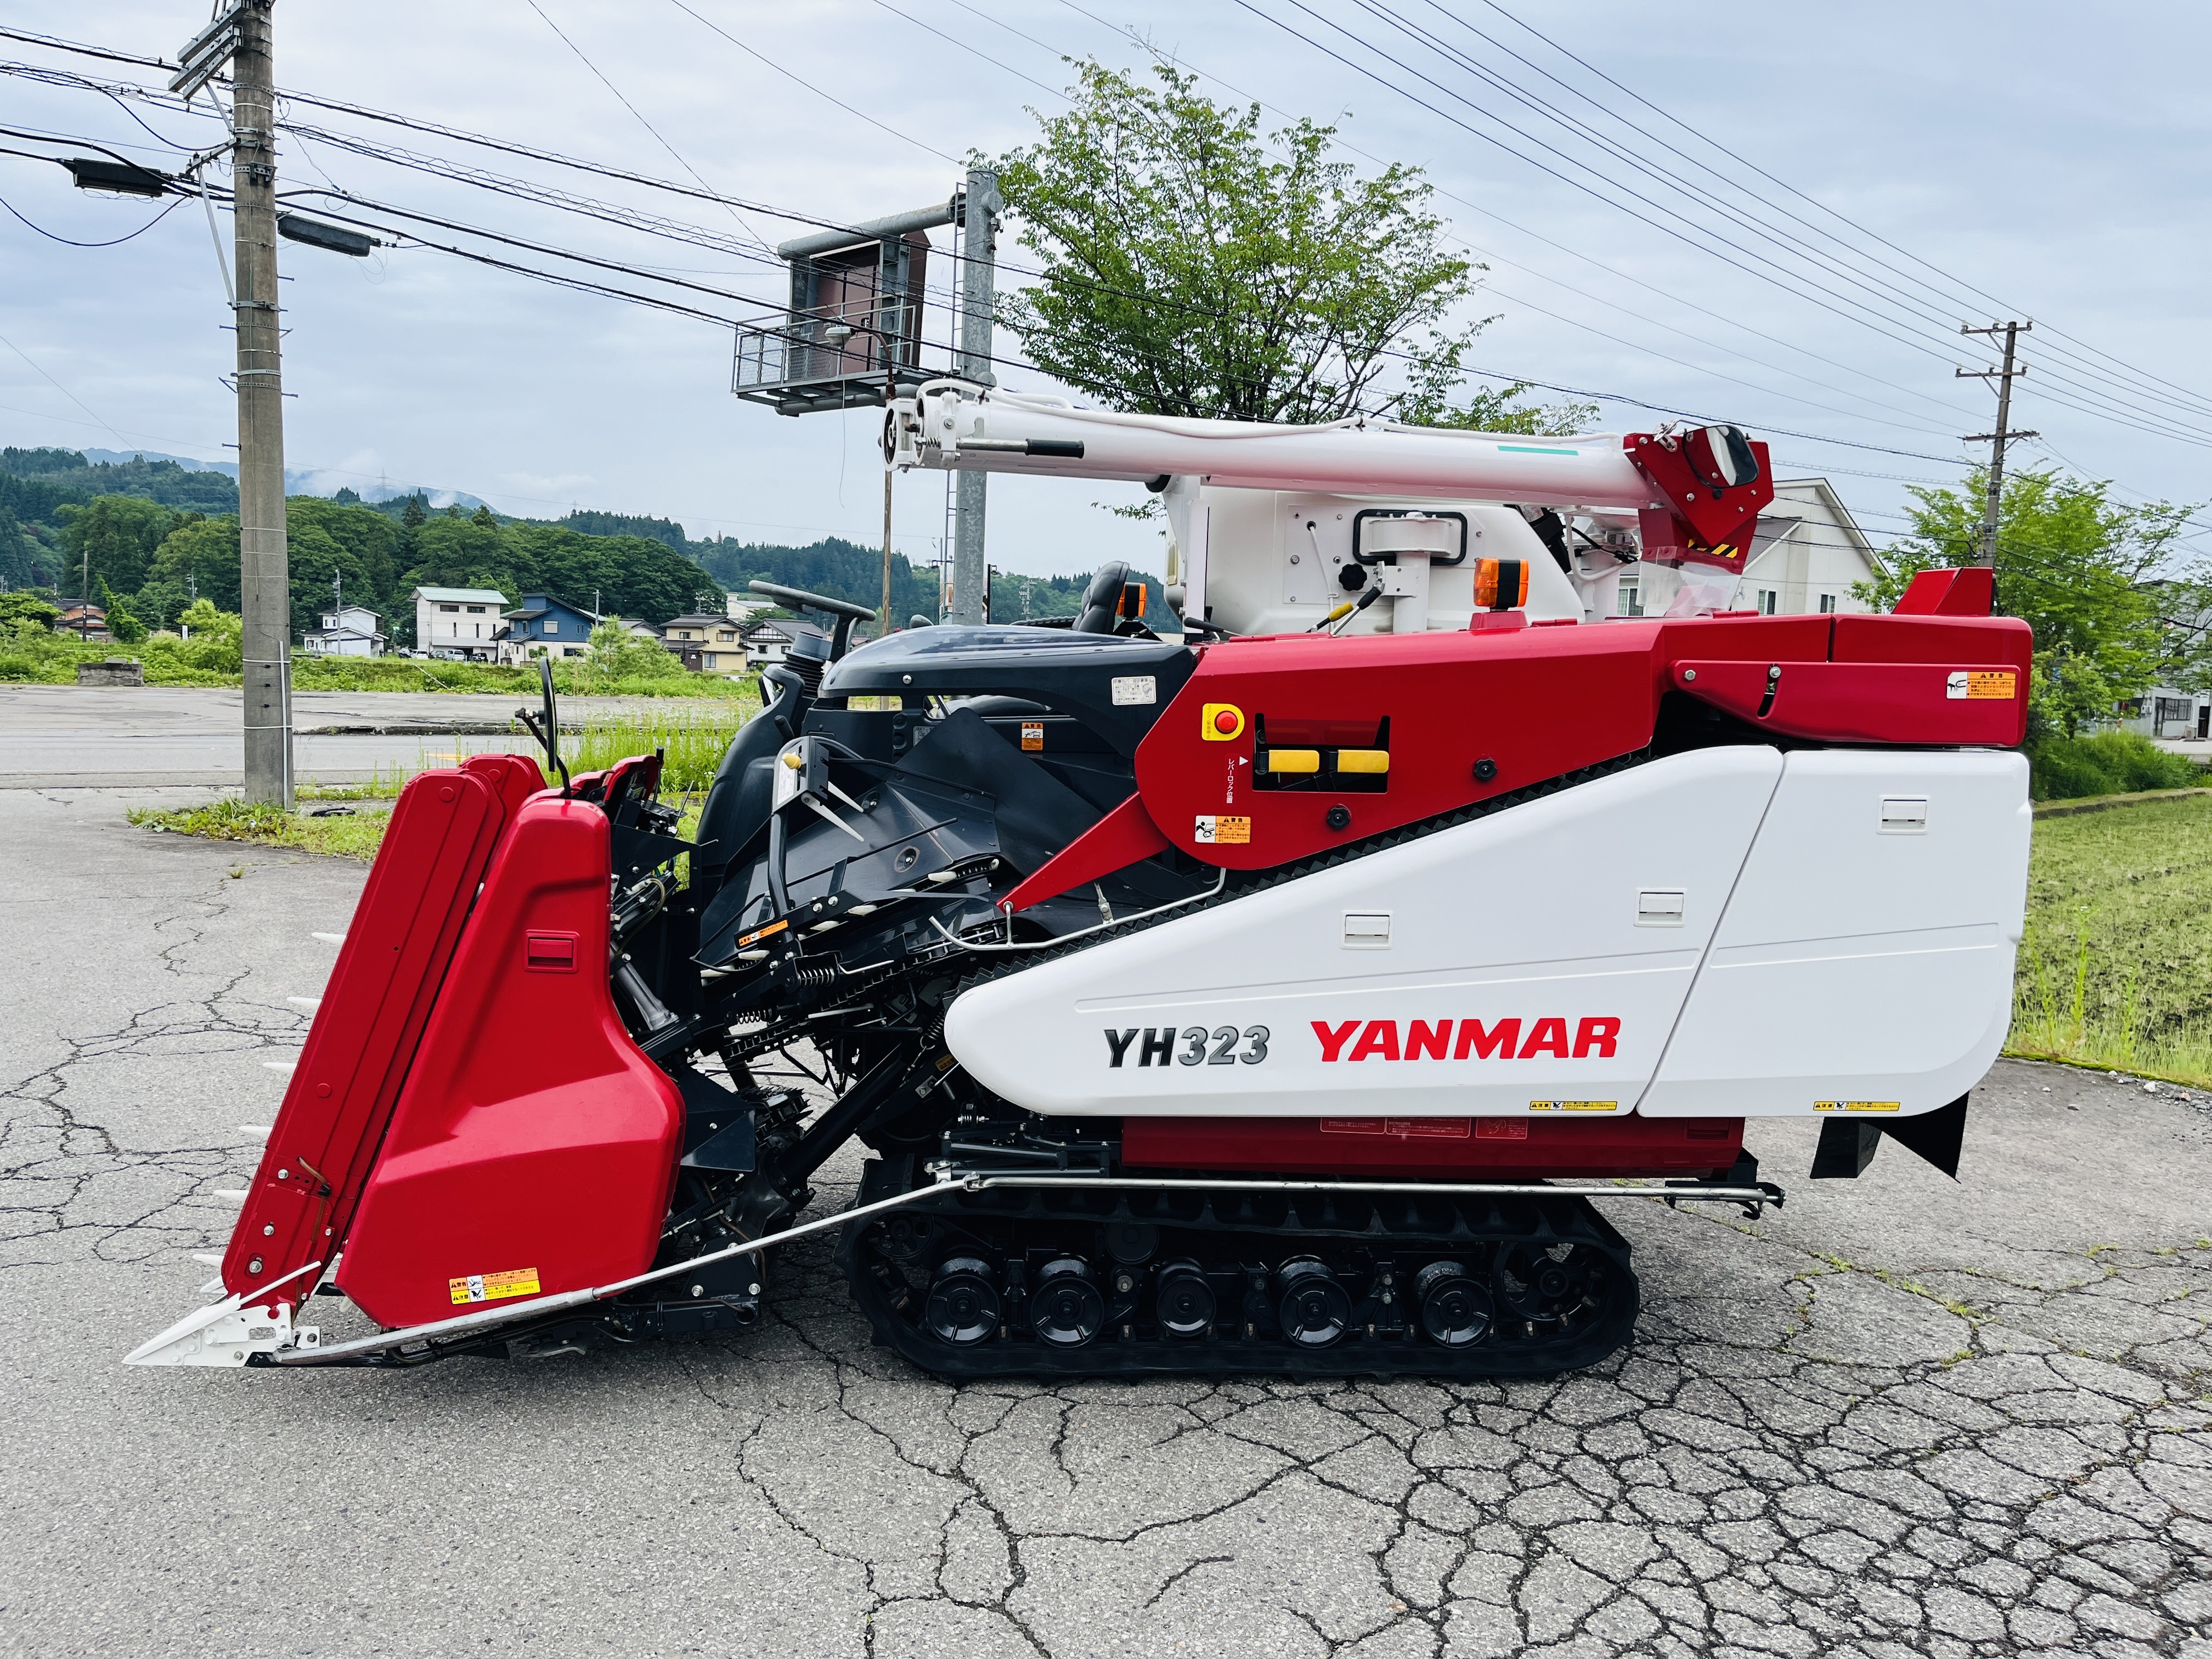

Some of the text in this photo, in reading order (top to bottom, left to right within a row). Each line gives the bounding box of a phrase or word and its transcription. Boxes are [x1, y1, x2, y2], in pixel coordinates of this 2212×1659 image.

[1226, 758, 1234, 804] レバーロック位置
[1103, 1025, 1270, 1068] YH323
[1310, 1017, 1621, 1062] YANMAR
